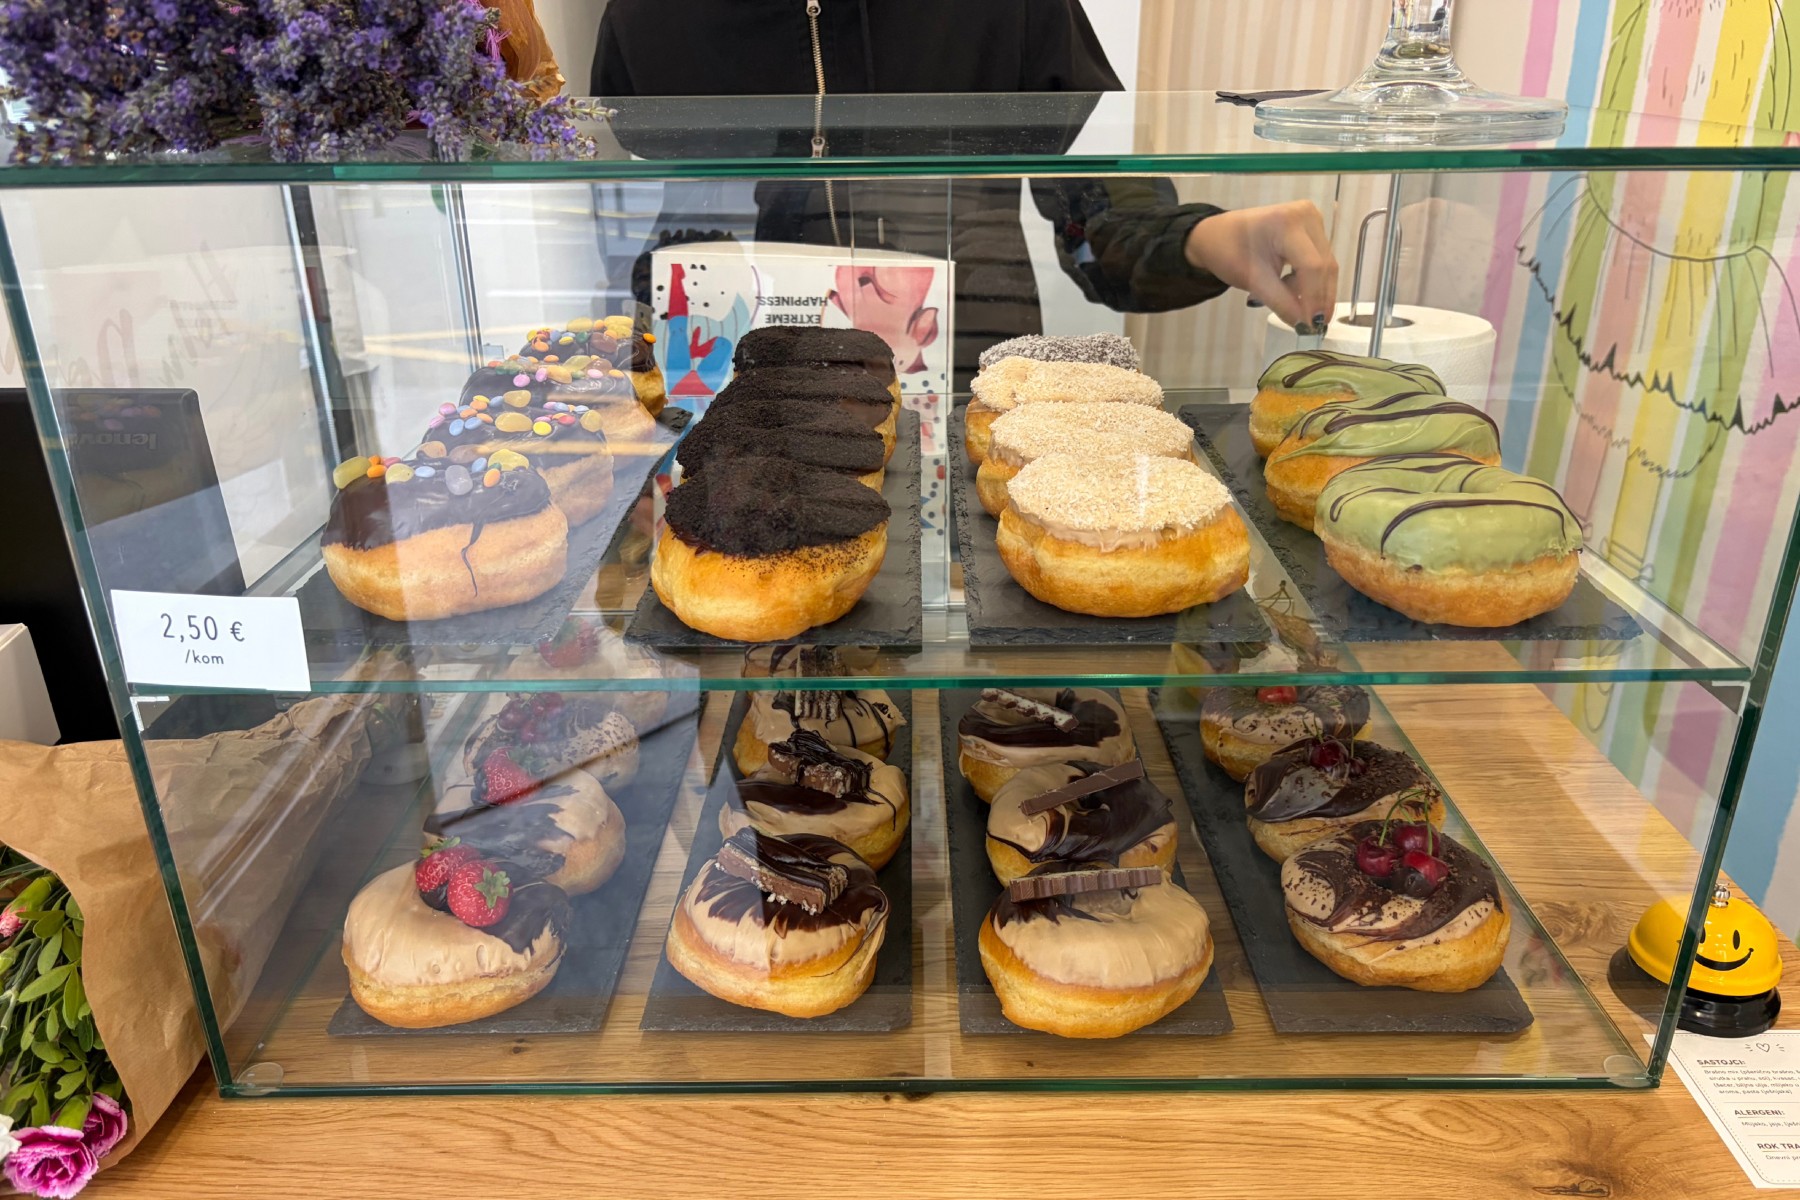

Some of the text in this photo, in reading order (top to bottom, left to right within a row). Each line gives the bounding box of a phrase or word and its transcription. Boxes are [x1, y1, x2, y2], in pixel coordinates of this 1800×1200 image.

[765, 314, 821, 324] EXTREME
[160, 613, 245, 643] 2,50 €
[185, 649, 224, 665] /kom
